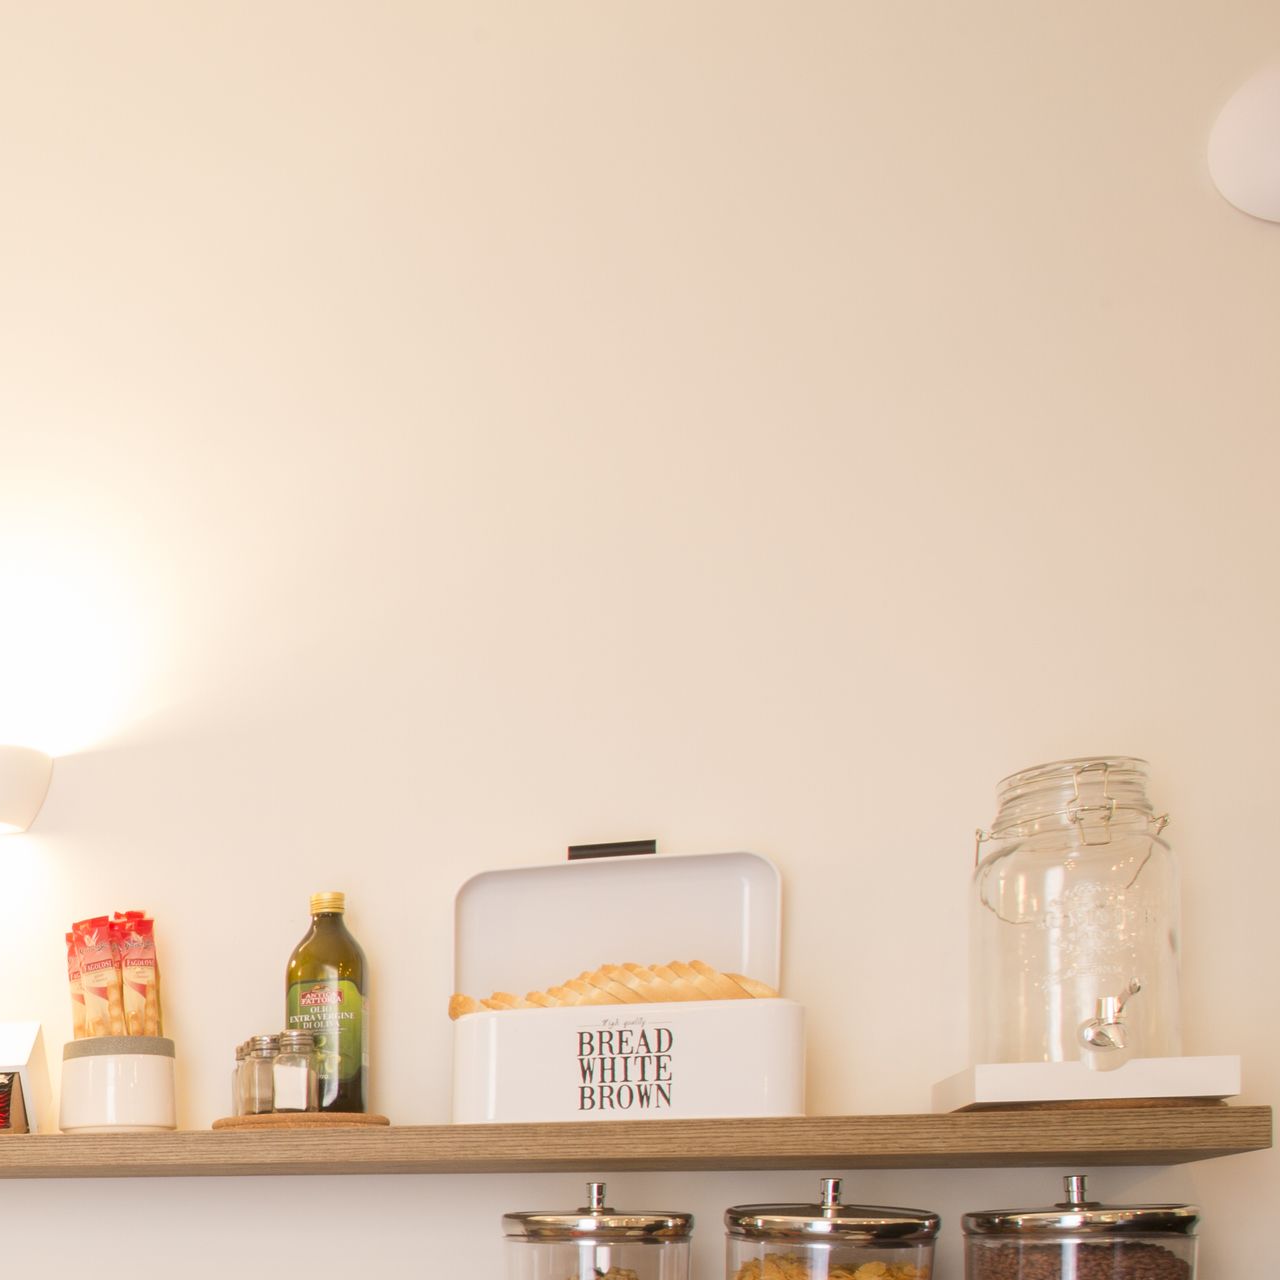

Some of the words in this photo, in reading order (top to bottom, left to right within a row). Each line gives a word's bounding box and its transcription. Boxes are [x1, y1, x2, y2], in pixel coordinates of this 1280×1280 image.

[290, 1014, 315, 1023] EXTRA
[317, 1012, 355, 1021] VERGINE
[314, 1020, 342, 1029] OLIVA
[577, 1028, 673, 1056] BREAD
[578, 1055, 672, 1084] WHITE
[578, 1083, 672, 1110] BROWN
